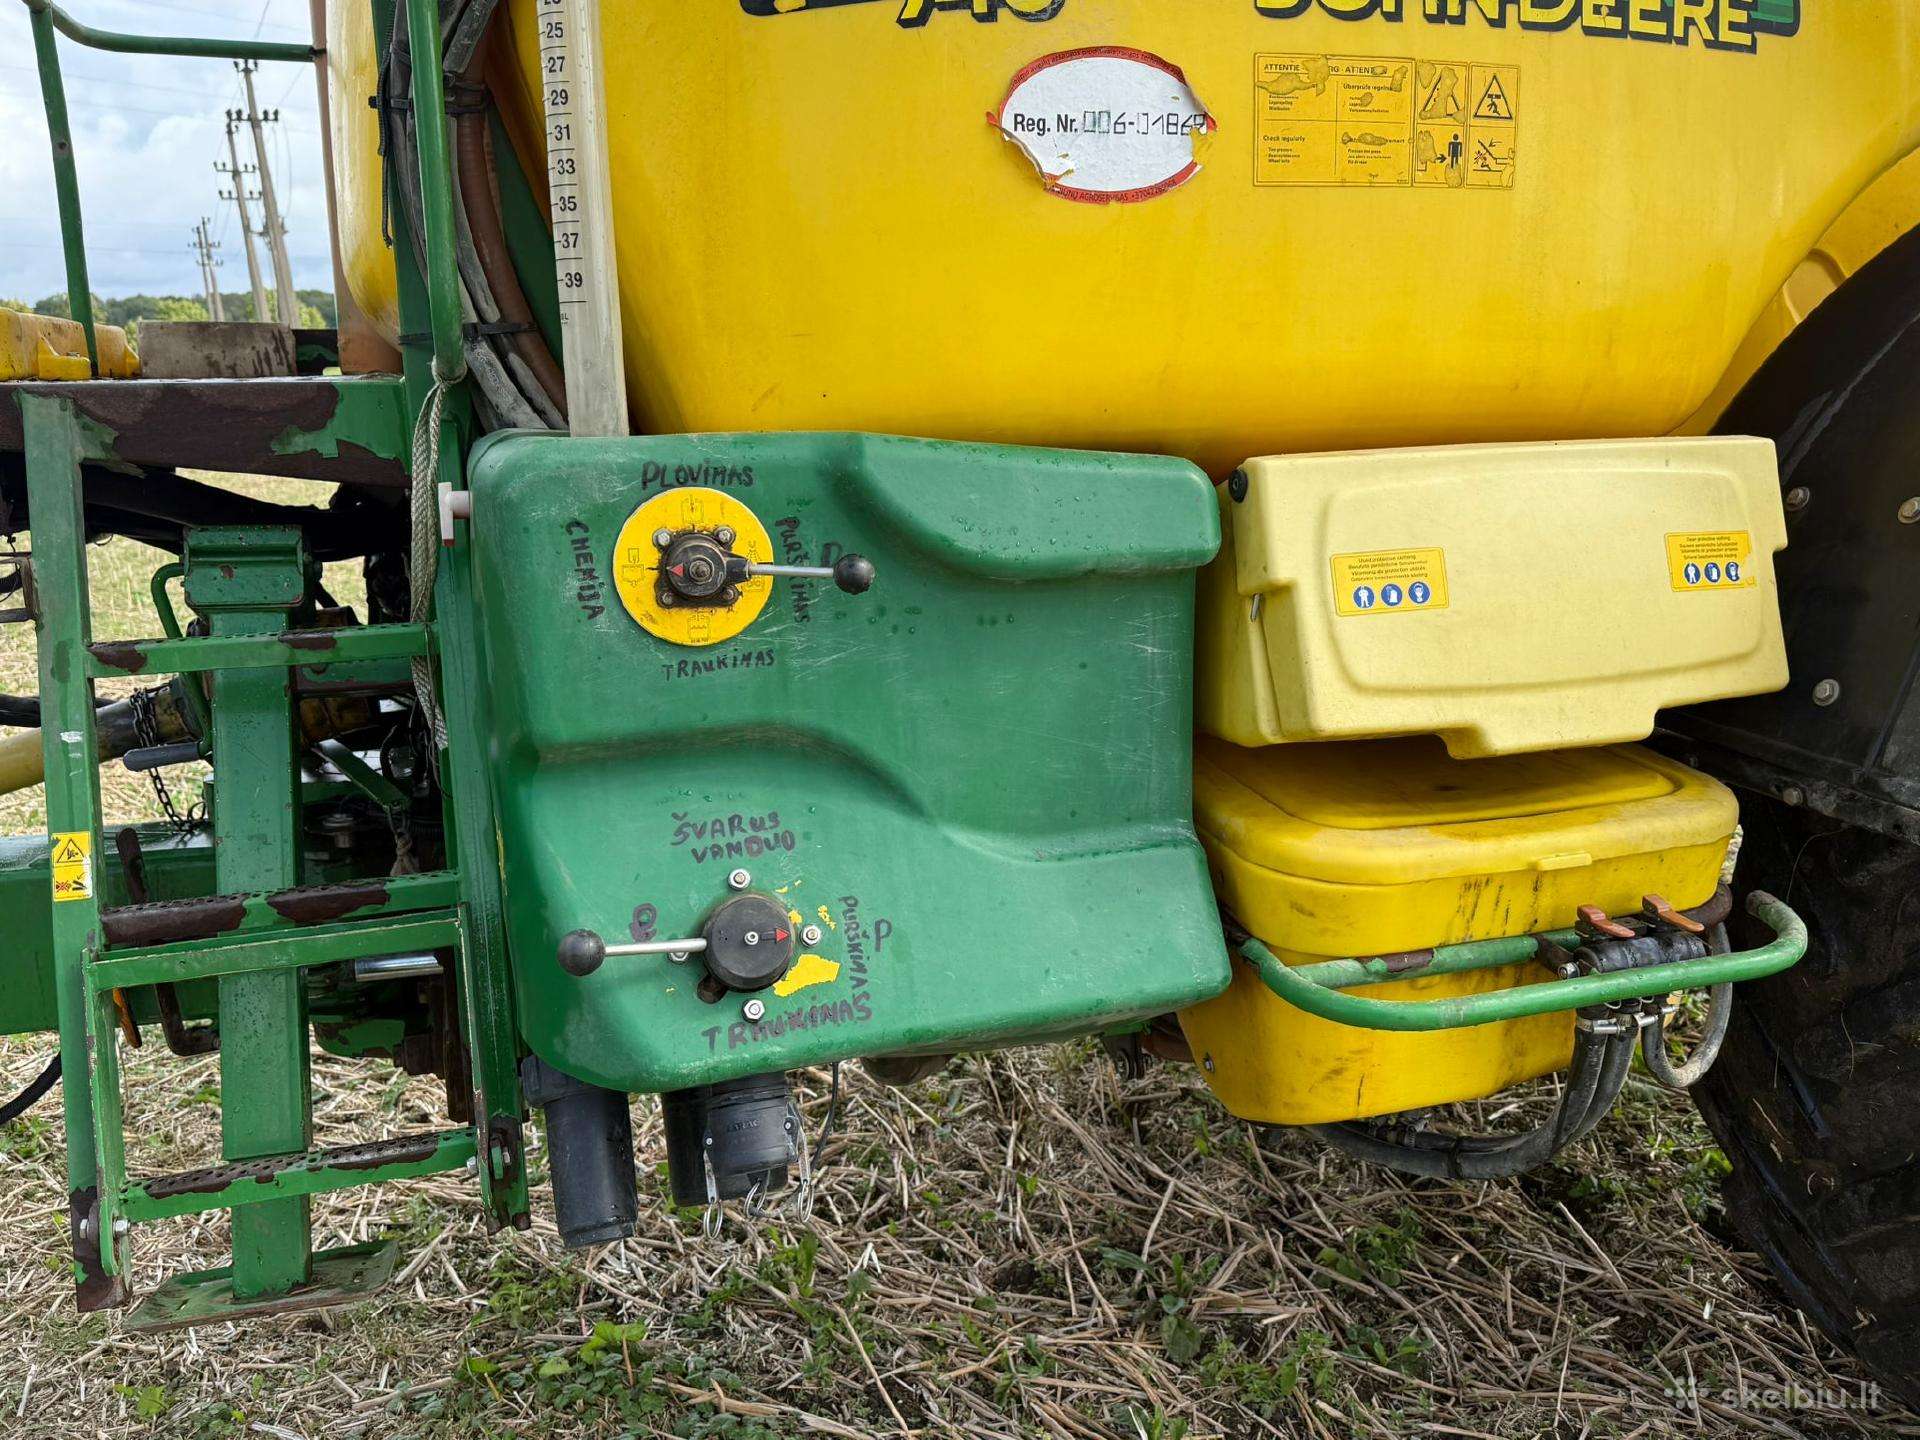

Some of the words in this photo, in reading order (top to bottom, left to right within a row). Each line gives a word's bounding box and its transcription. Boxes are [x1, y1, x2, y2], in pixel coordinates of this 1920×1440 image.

[546, 22, 564, 39] 25
[548, 56, 565, 73] 27
[1264, 63, 1300, 71] ATTENTIE
[550, 89, 569, 106] 29
[554, 124, 571, 141] 31
[1013, 113, 1050, 137] Reg.
[1056, 113, 1079, 134] Nr.
[557, 157, 576, 175] 33
[559, 196, 578, 212] 35
[562, 232, 579, 249] 37
[565, 272, 583, 288] 39
[642, 461, 755, 489] PLOVIMAS
[775, 515, 811, 624] PURŠIMAS
[661, 649, 776, 682] TRAUKIMAS
[670, 810, 782, 846] ŠVARUS
[874, 918, 893, 953] P
